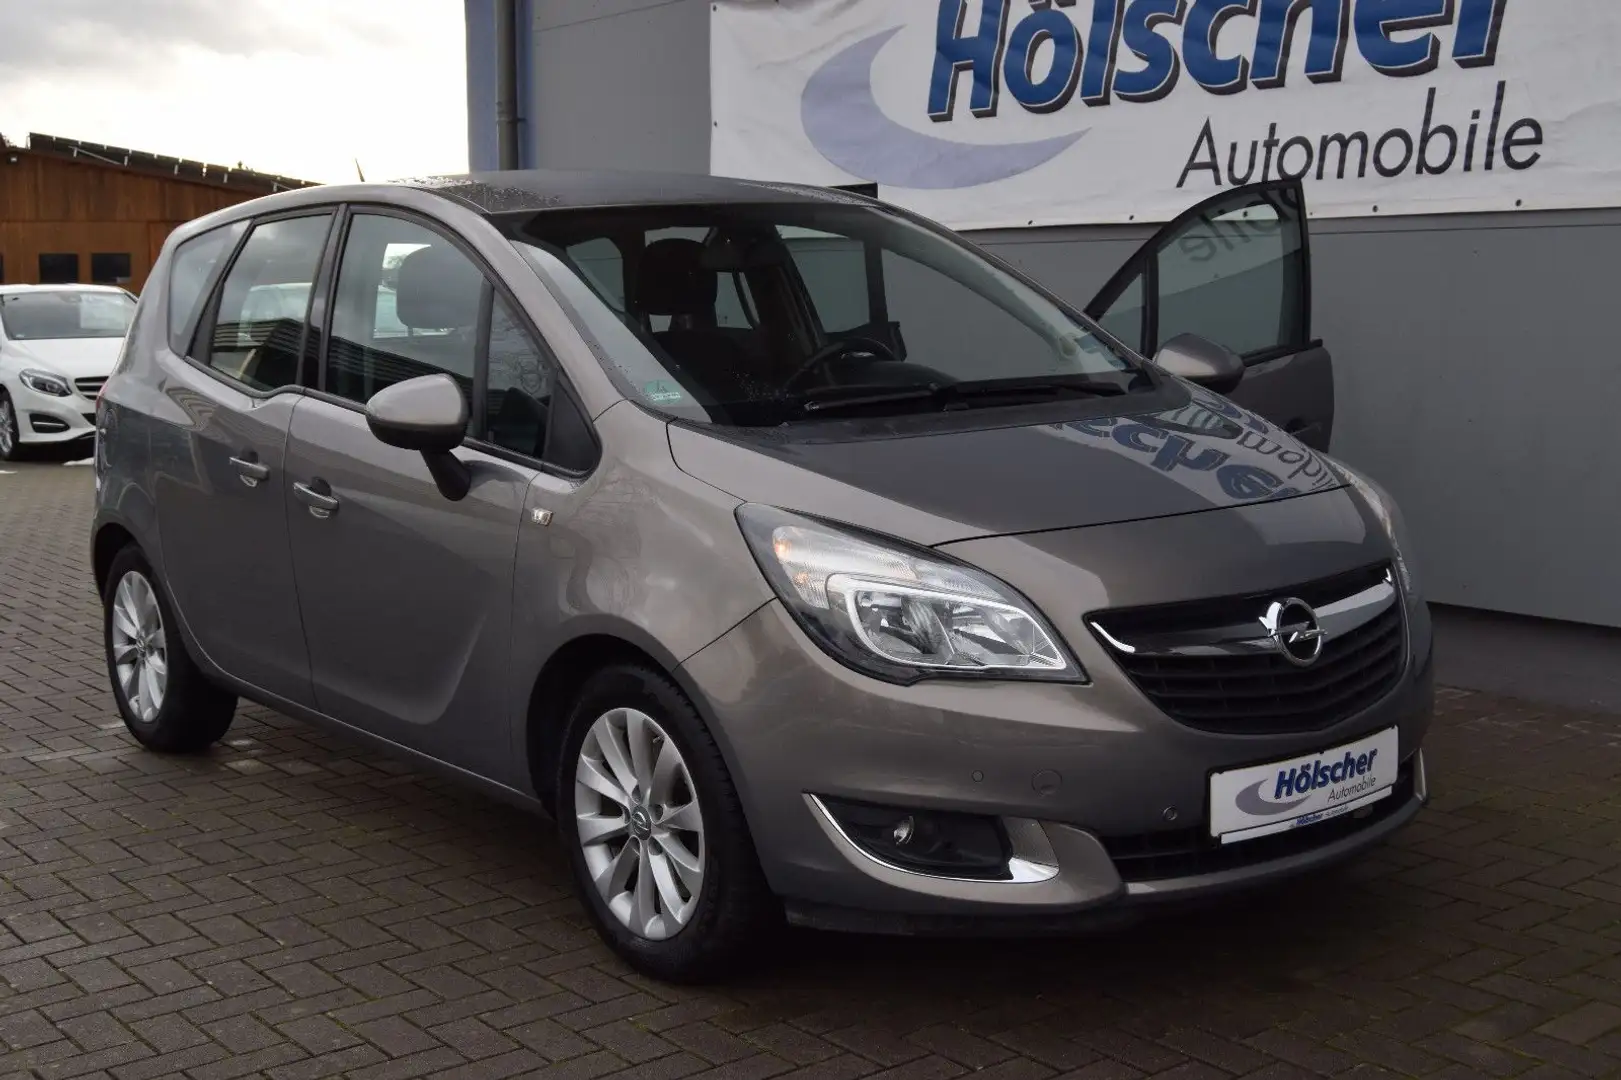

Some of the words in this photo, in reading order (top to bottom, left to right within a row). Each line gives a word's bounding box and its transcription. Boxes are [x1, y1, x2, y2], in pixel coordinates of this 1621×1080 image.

[1176, 80, 1543, 188] Automobile
[1275, 749, 1378, 799] Hölscher
[1328, 775, 1376, 802] Automobile
